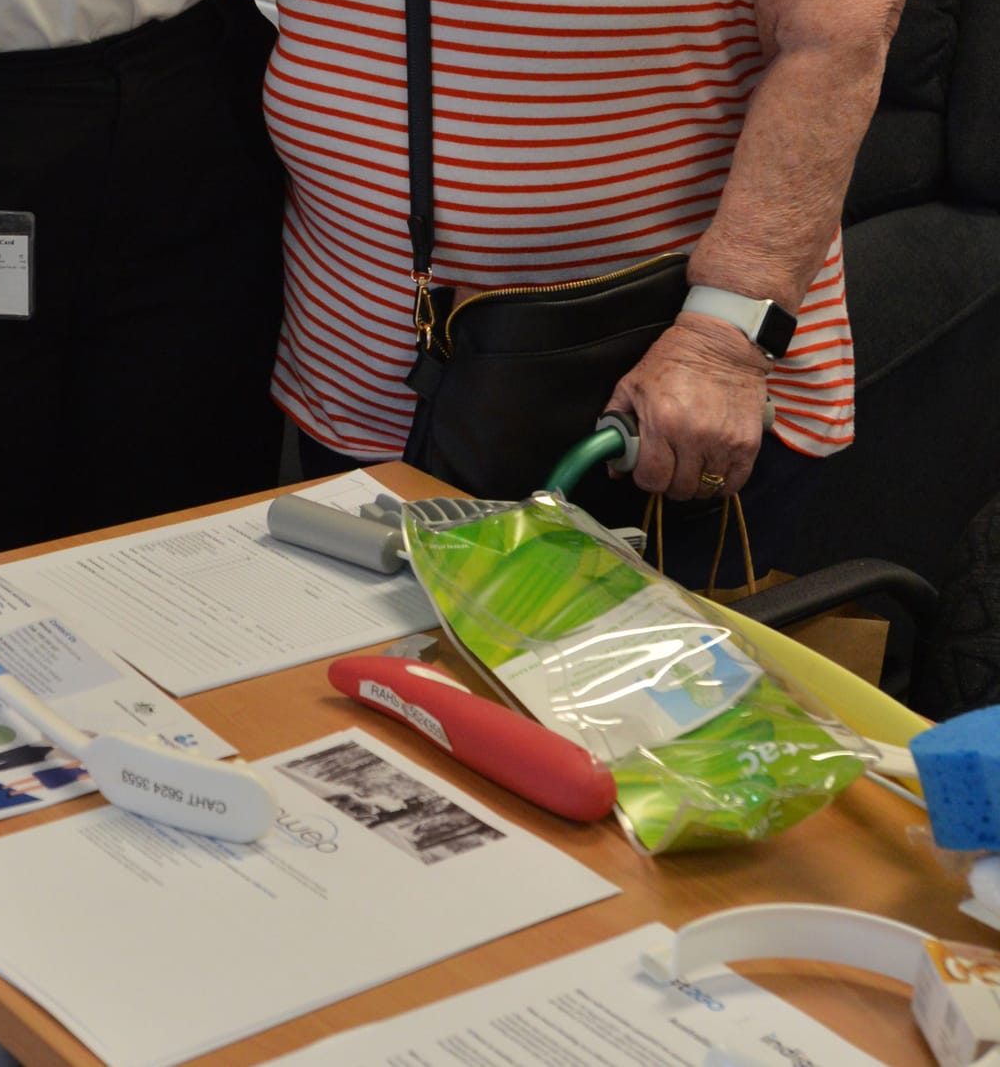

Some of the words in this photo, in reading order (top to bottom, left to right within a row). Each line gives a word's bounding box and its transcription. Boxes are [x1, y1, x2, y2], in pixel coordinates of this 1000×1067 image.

[121, 769, 150, 791] 3553
[153, 782, 183, 803] 5624
[187, 793, 227, 814] CAHT
